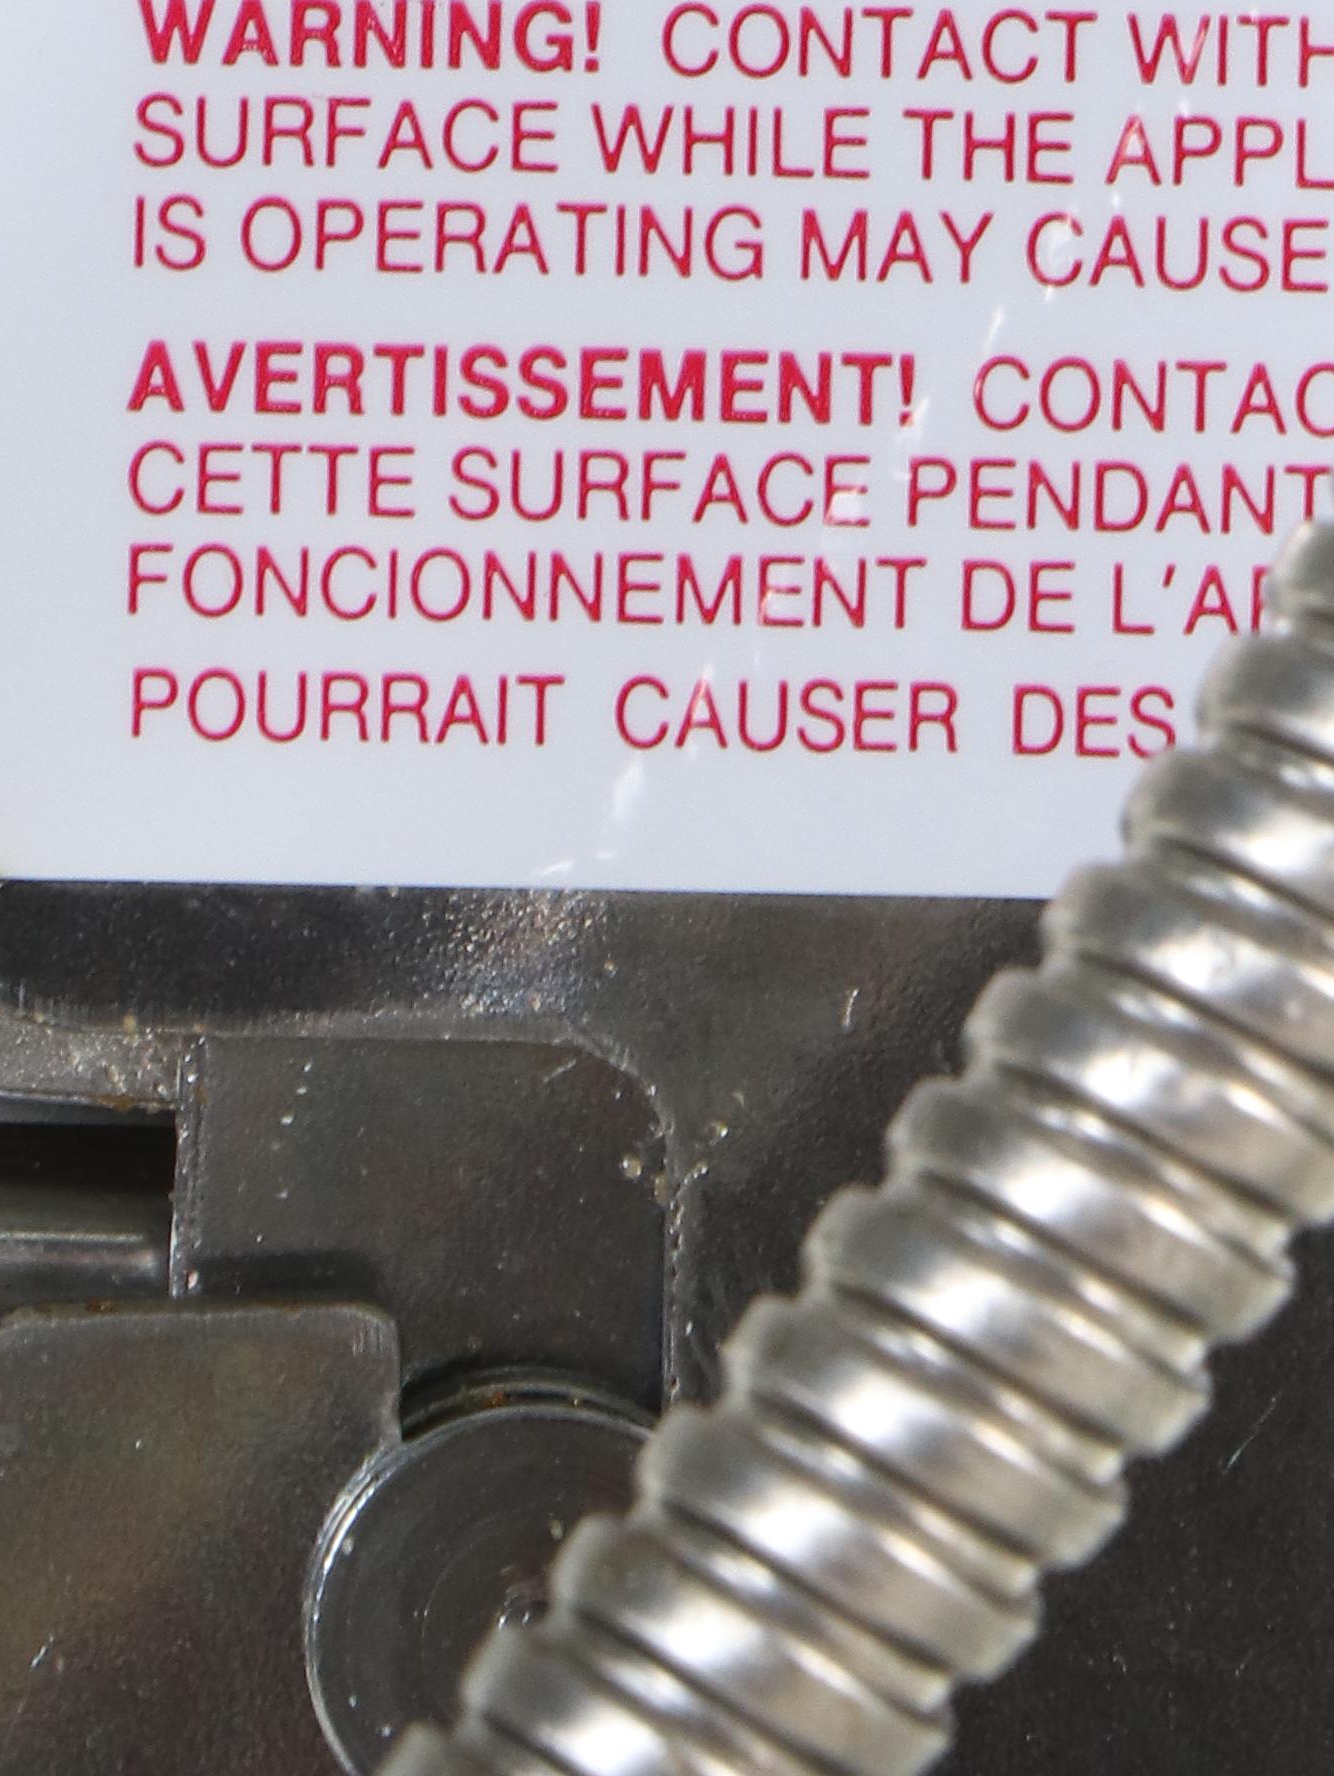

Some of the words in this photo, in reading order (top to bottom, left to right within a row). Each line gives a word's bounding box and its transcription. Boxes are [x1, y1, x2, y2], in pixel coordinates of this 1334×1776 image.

[660, 0, 1100, 86] CONTACT
[132, 90, 560, 174] SURFACE
[589, 101, 872, 181] WHILE
[901, 106, 1076, 186] THE
[132, 191, 209, 272] IS
[239, 193, 765, 283] OPERATING
[799, 206, 994, 285] MAY
[1025, 209, 1330, 294] CAUSE
[125, 338, 917, 427] AVERTISSEMENT!
[127, 437, 417, 519] CETTE
[447, 443, 872, 528] SURFACE
[905, 453, 1333, 536] PENDANT
[126, 540, 929, 630] FONCIONNEMENT
[960, 557, 1076, 635] DE
[130, 666, 566, 747] POURRAIT
[613, 672, 960, 754] CAUSER
[1010, 681, 1178, 760] DES
